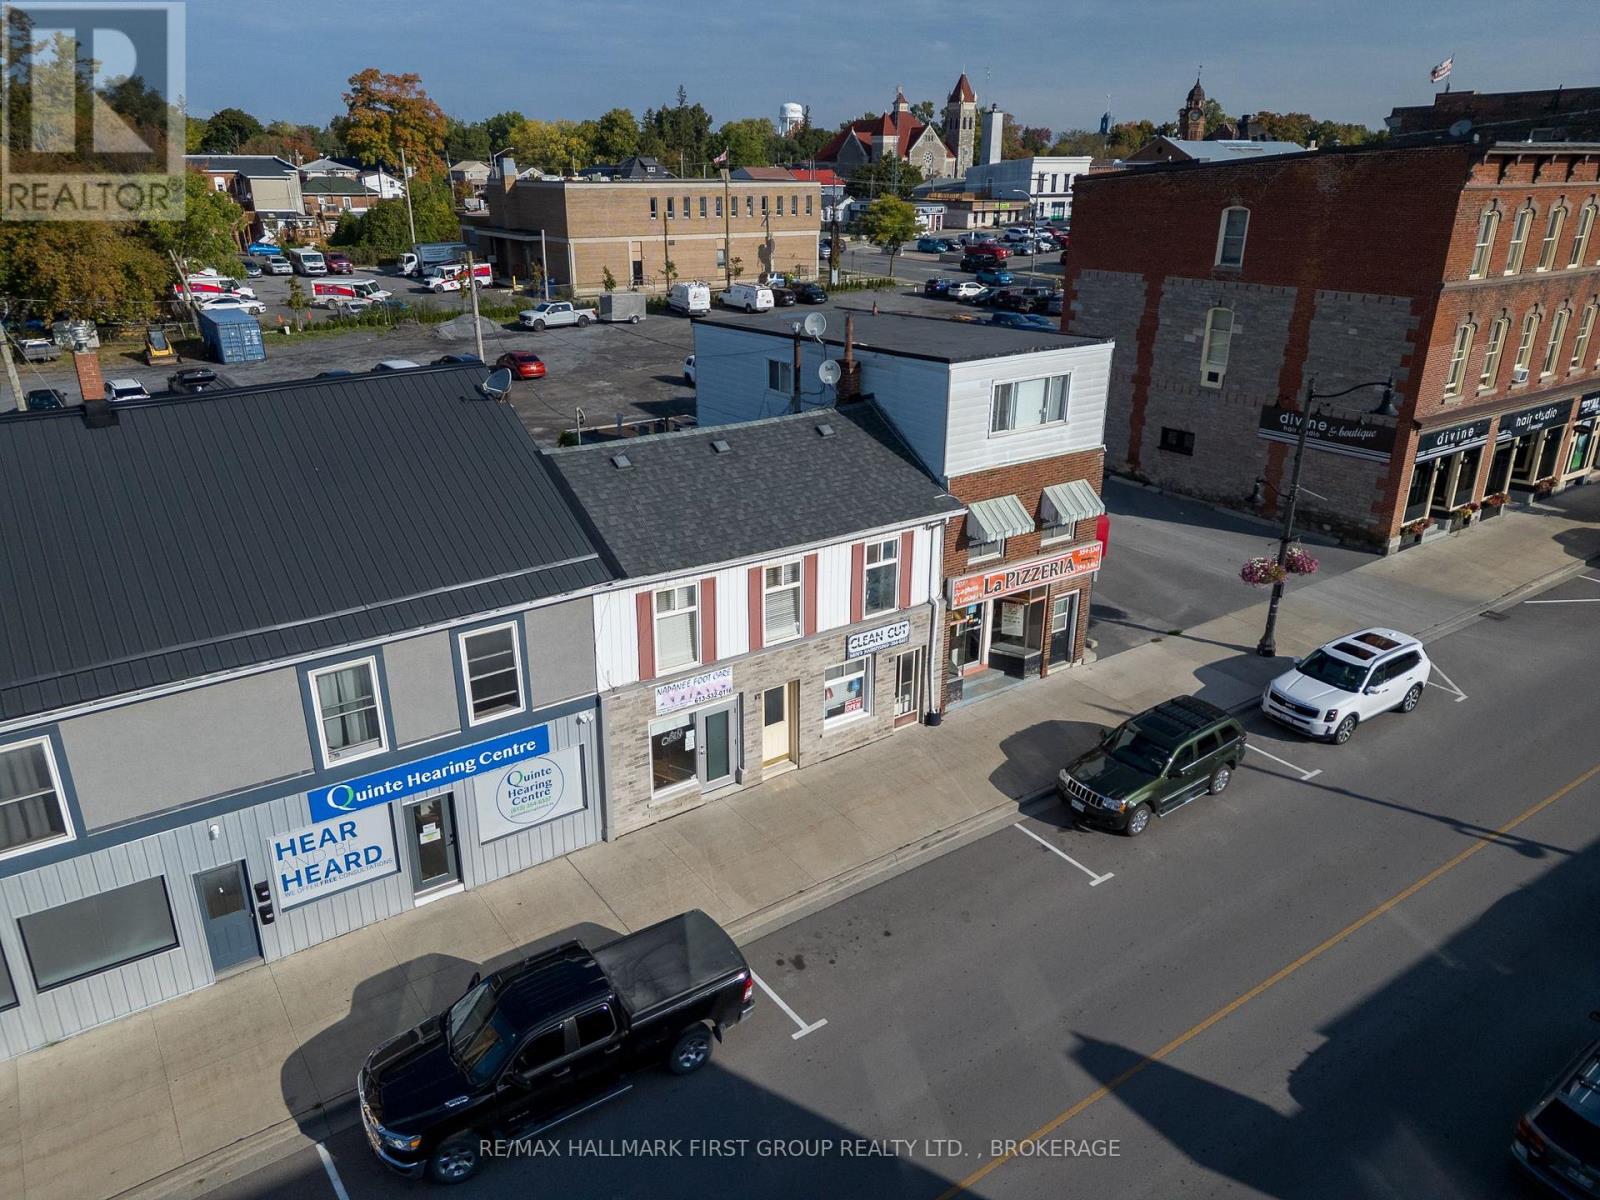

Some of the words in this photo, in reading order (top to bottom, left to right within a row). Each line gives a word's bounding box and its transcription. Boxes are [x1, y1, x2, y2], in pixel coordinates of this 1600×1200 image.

[1279, 412, 1328, 431] divne
[1338, 425, 1377, 440] boutique
[1283, 425, 1297, 434] hair
[1516, 413, 1533, 427] hair
[1437, 427, 1475, 446] divine
[984, 577, 1002, 595] La
[1006, 558, 1075, 589] PIZZERIA
[850, 630, 884, 649] CLEAN
[887, 623, 908, 639] CUT
[657, 680, 690, 696] NAPANEE
[693, 674, 712, 687] FOOT
[713, 667, 732, 681] CARE
[327, 780, 404, 811] Quinte
[407, 757, 477, 787] Hearing
[479, 741, 537, 765] Centre
[507, 767, 552, 788] Quinte
[508, 779, 553, 799] Hearing
[512, 788, 551, 806] Centre
[275, 820, 358, 861] HEAR
[281, 848, 327, 873] AND
[281, 845, 383, 892] HEARD
[320, 876, 338, 887] FREE
[338, 857, 393, 880] CONSULTATIONS
